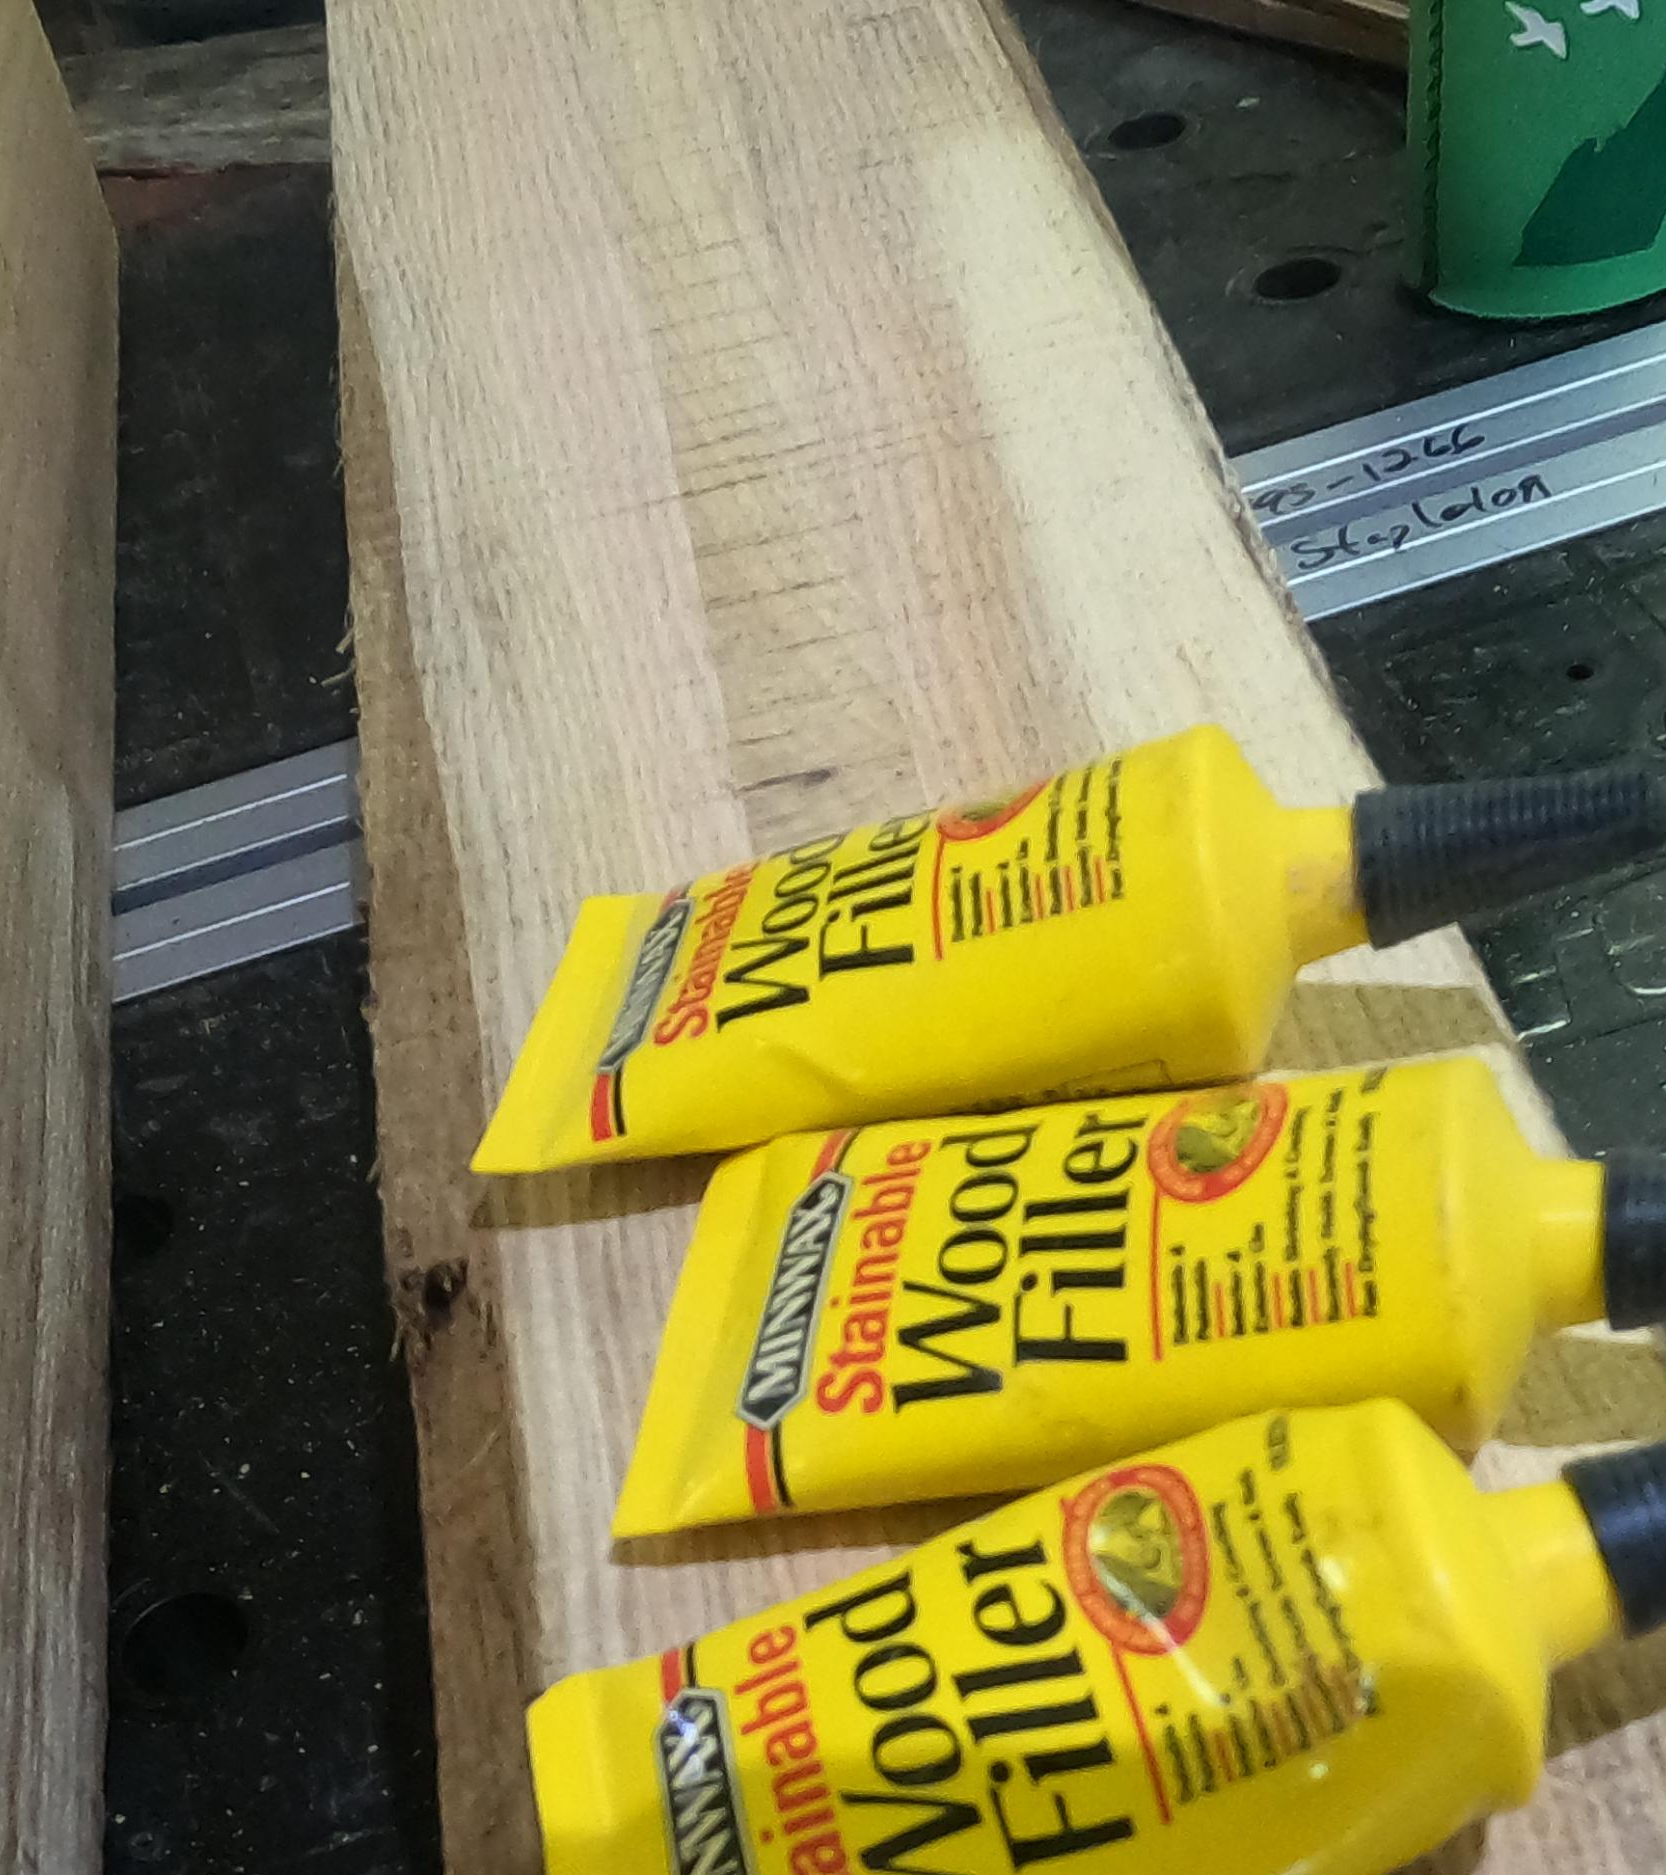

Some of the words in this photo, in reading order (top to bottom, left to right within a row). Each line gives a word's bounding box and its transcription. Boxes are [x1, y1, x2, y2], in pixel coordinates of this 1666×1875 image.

[717, 832, 848, 1033] Wood
[819, 810, 939, 981] Fille
[746, 1186, 837, 1402] MINWAX
[816, 1140, 932, 1415] Stainable
[893, 1122, 1040, 1413] Wood
[1013, 1112, 1149, 1367] Filler
[955, 1538, 1135, 1874] Filler
